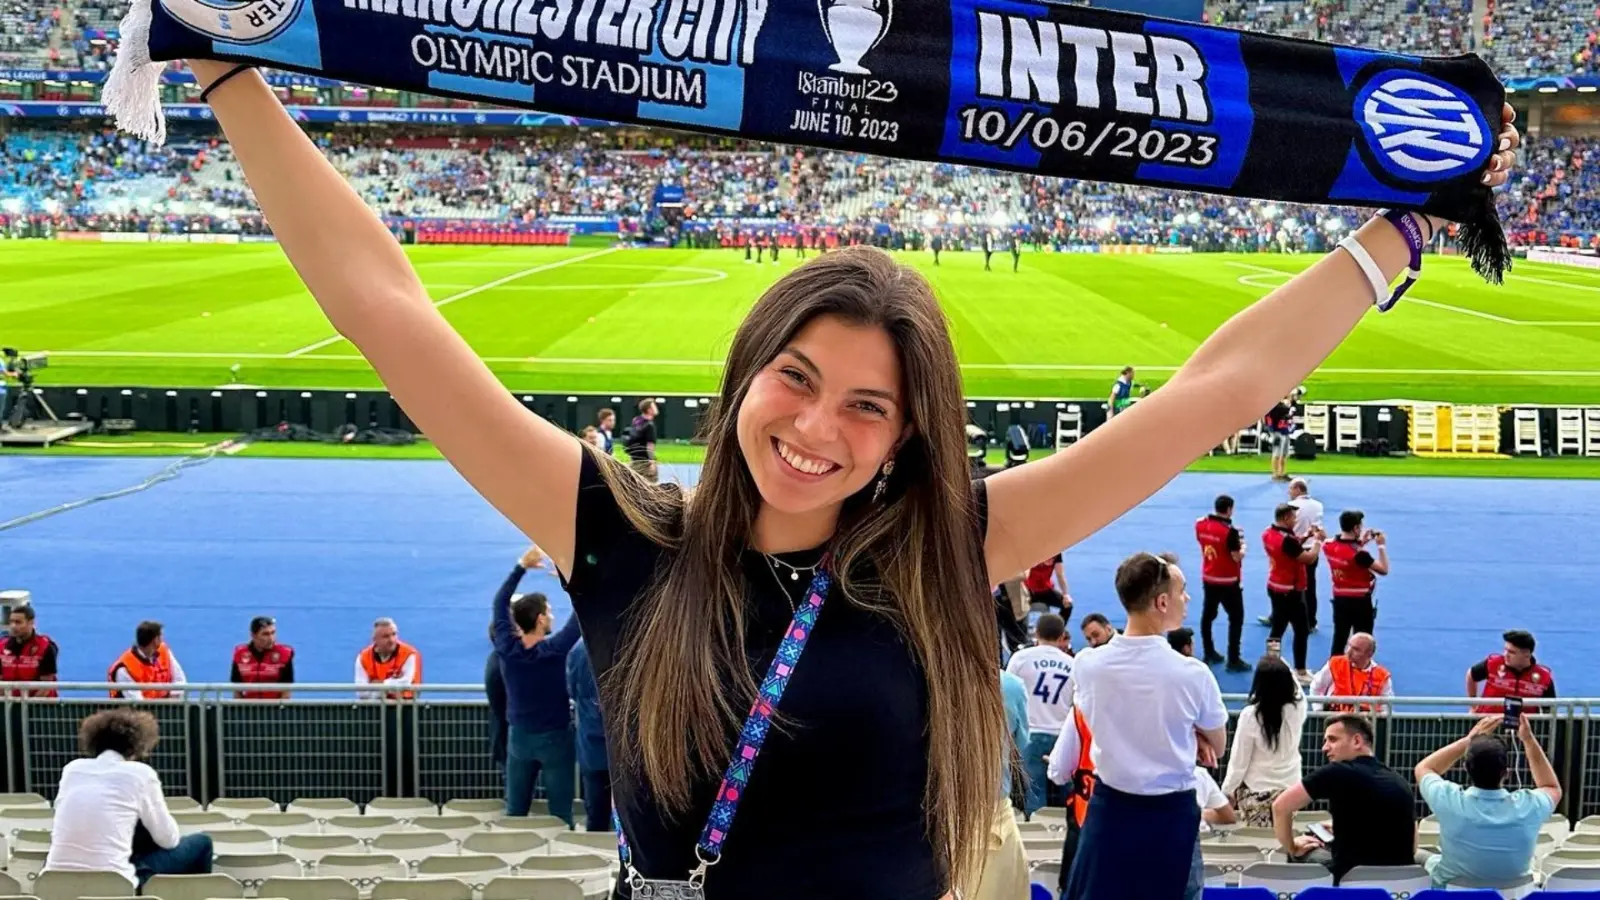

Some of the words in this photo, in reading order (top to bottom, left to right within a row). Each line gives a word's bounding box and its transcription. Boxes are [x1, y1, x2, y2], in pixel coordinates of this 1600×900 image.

[662, 0, 768, 64] CITY
[411, 34, 554, 83] OLYMPIC
[561, 55, 702, 104] STADIUM
[979, 12, 1208, 122] INTER
[412, 112, 458, 122] FINAL
[812, 97, 871, 115] FINAL
[790, 109, 831, 133] JUNE
[835, 114, 854, 137] 10.
[859, 118, 899, 142] 2023
[961, 108, 1216, 165] 10/06/2023
[1033, 659, 1072, 674] FODEN
[1033, 671, 1069, 705] 47
